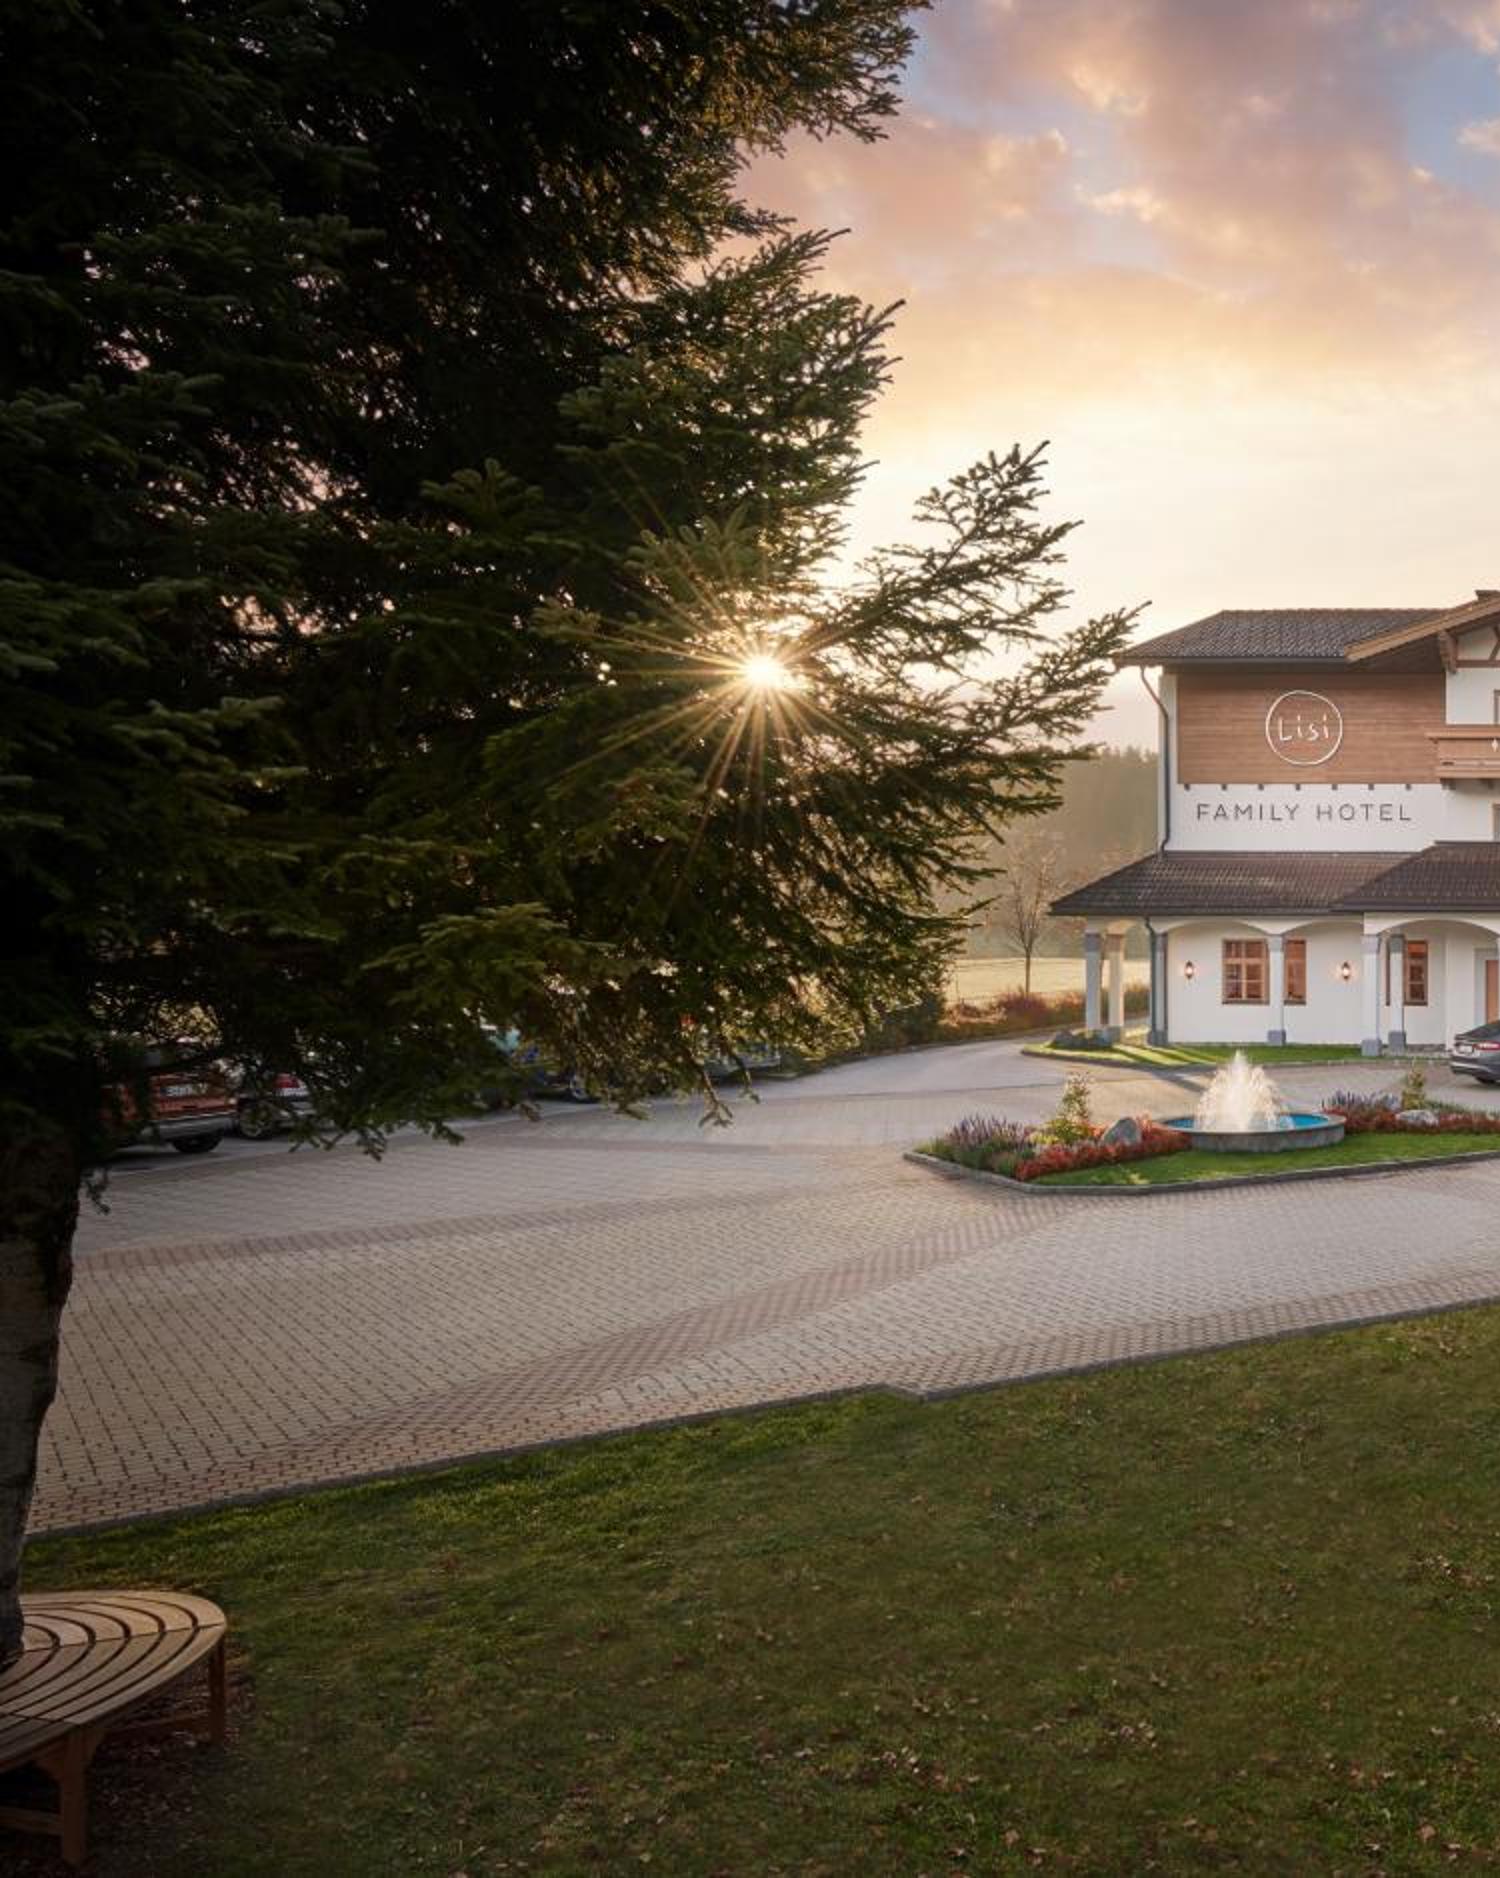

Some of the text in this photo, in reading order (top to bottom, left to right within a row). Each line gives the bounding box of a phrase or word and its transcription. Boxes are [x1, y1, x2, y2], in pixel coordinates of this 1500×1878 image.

[1277, 714, 1329, 741] Lisi
[1196, 803, 1411, 821] FAMILY HOTEL
